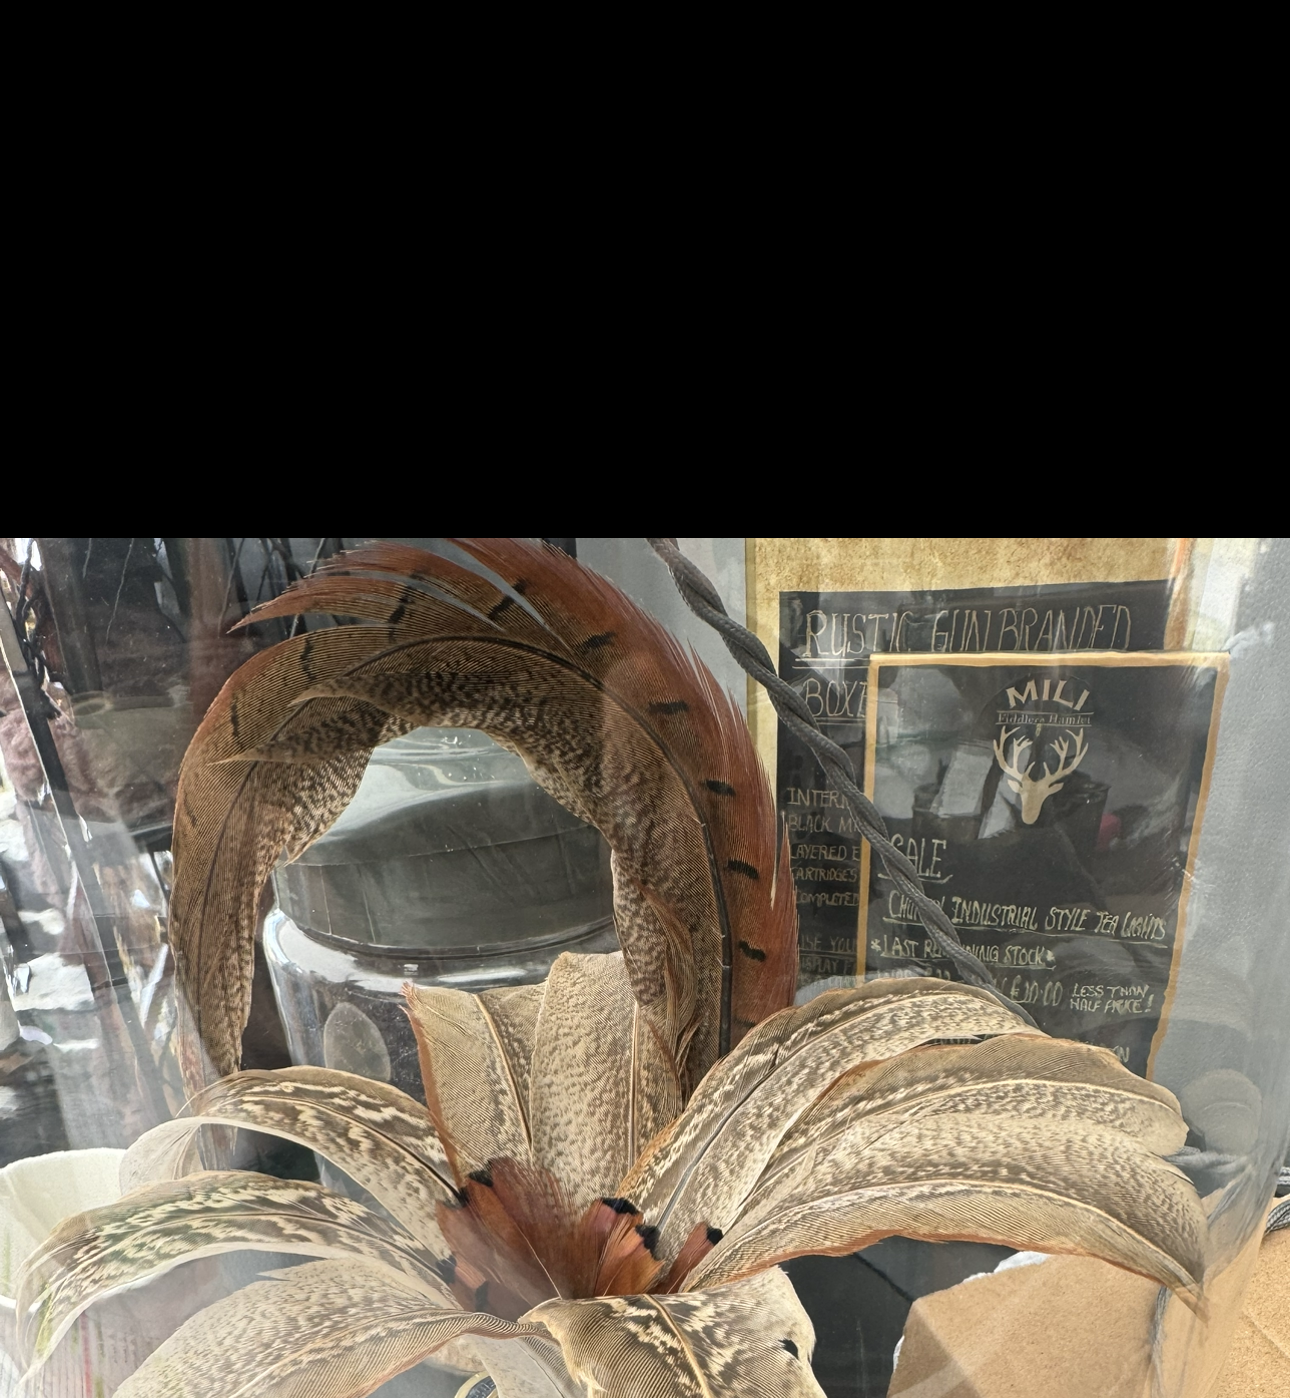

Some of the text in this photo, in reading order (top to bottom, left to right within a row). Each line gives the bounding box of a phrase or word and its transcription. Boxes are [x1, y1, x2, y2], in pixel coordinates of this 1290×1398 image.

[803, 604, 1132, 658] RUSTIC GUN BRANDED
[1005, 679, 1090, 711] MILI
[788, 814, 834, 833] BLACK
[951, 896, 1039, 931] INDUSTRIAL
[1045, 906, 1091, 932] STYLE
[1094, 910, 1120, 937] TEA
[1071, 982, 1150, 998] LESS THAN
[1069, 997, 1103, 1013] HALF
